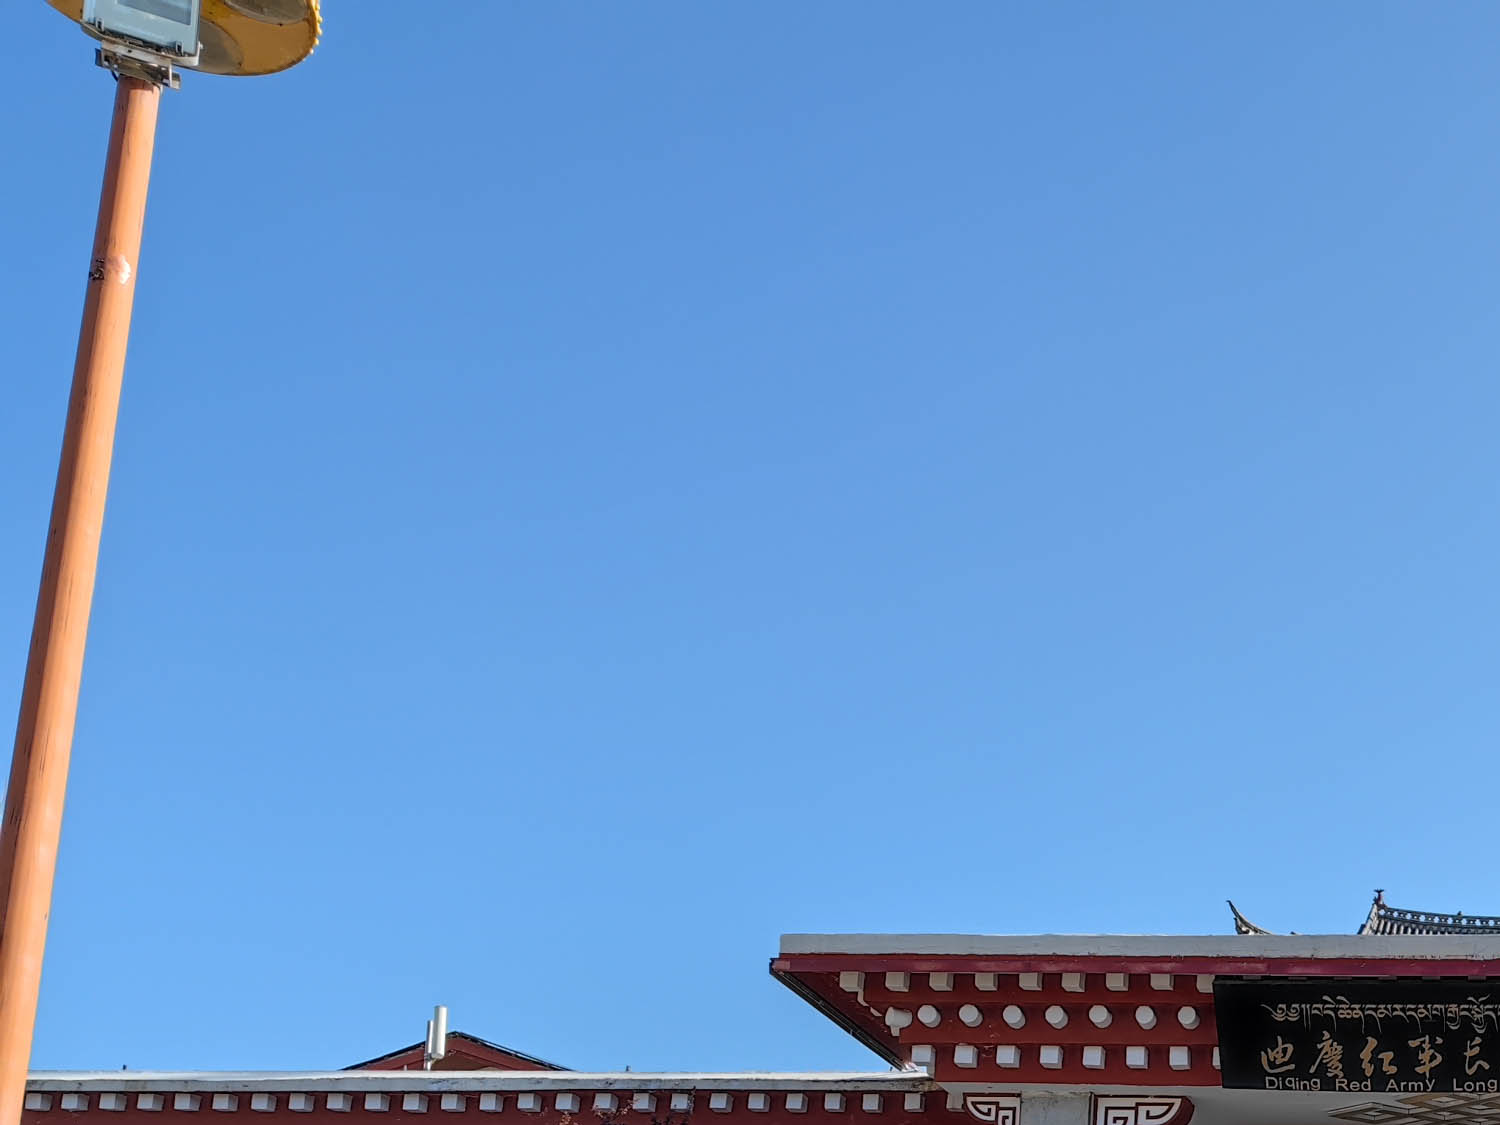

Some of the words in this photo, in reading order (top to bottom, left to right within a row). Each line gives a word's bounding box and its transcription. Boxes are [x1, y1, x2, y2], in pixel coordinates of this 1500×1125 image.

[1265, 1076, 1321, 1091] Diqing
[1335, 1078, 1371, 1091] Red
[1385, 1078, 1436, 1092] Army
[1452, 1078, 1498, 1092] Long
